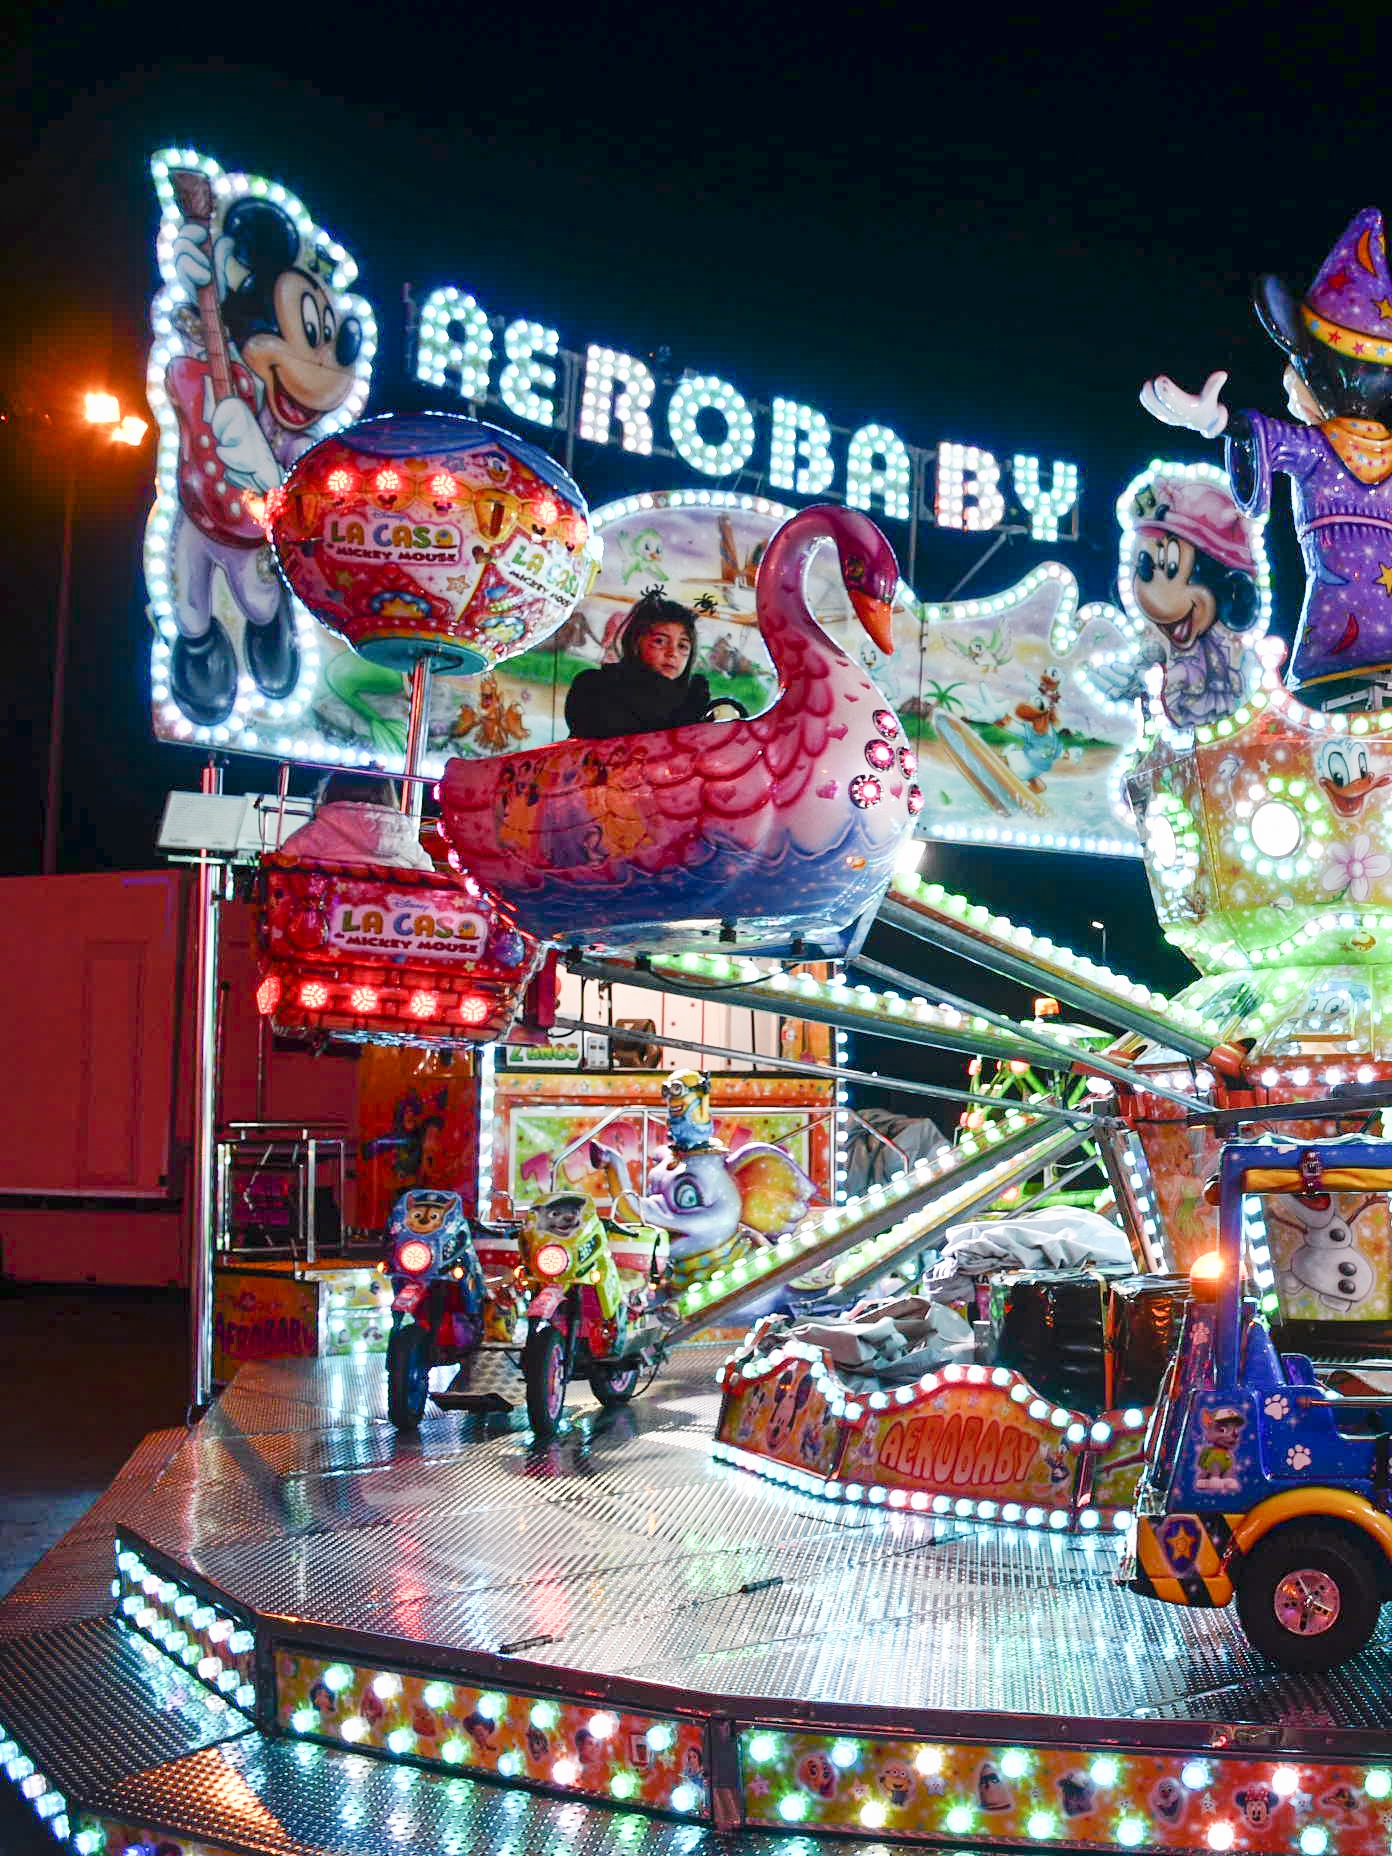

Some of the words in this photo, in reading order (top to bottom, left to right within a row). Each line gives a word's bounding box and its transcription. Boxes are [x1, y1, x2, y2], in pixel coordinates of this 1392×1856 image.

[415, 286, 1078, 542] AEROBABY
[331, 520, 365, 546] LA
[336, 546, 393, 560] MICKEY
[398, 551, 456, 562] MOUSE
[511, 545, 545, 576] LA
[342, 910, 383, 936] LA
[346, 936, 412, 950] MICKEY
[418, 941, 479, 954] MOUSE
[879, 1413, 1040, 1486] AEROBABY
